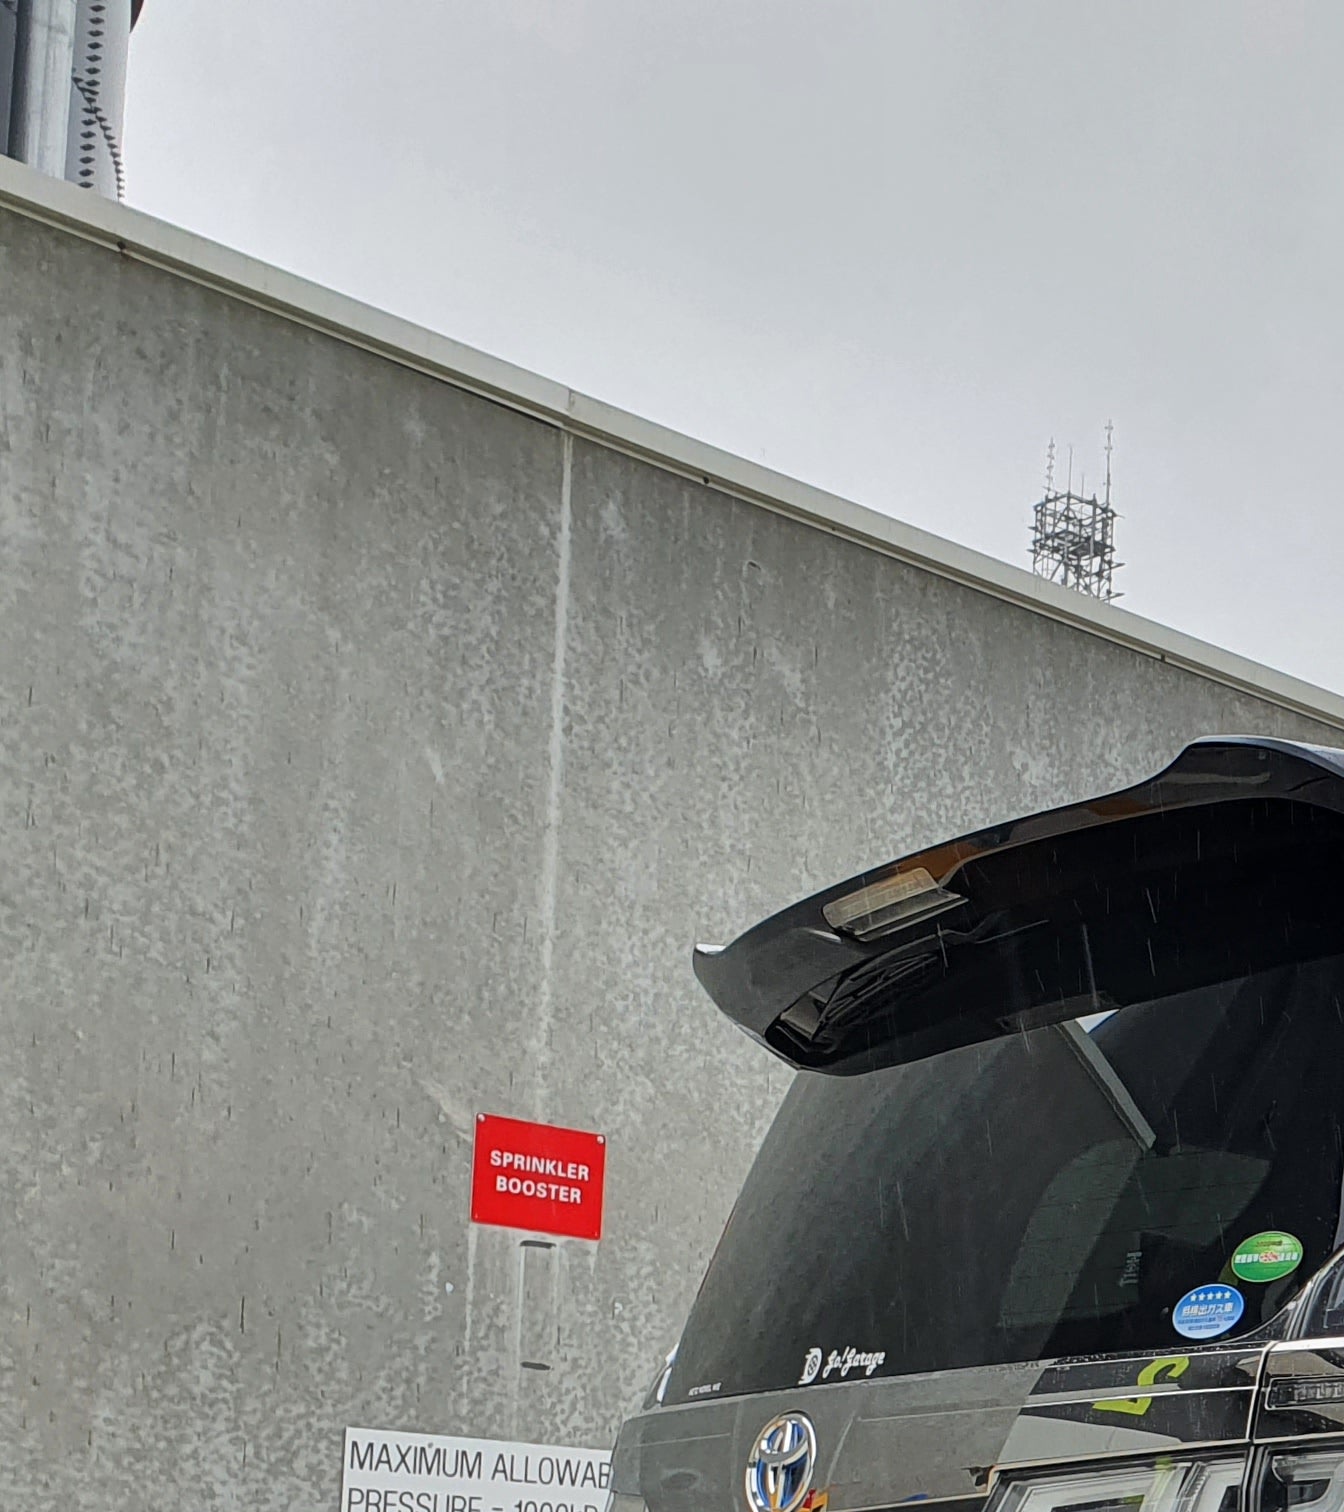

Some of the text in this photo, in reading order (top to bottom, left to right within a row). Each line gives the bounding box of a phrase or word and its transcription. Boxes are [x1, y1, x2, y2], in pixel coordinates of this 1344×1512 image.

[490, 1149, 589, 1181] SPRINKLER
[495, 1175, 581, 1204] BOOSTER
[350, 1440, 482, 1480] MAXIMUM
